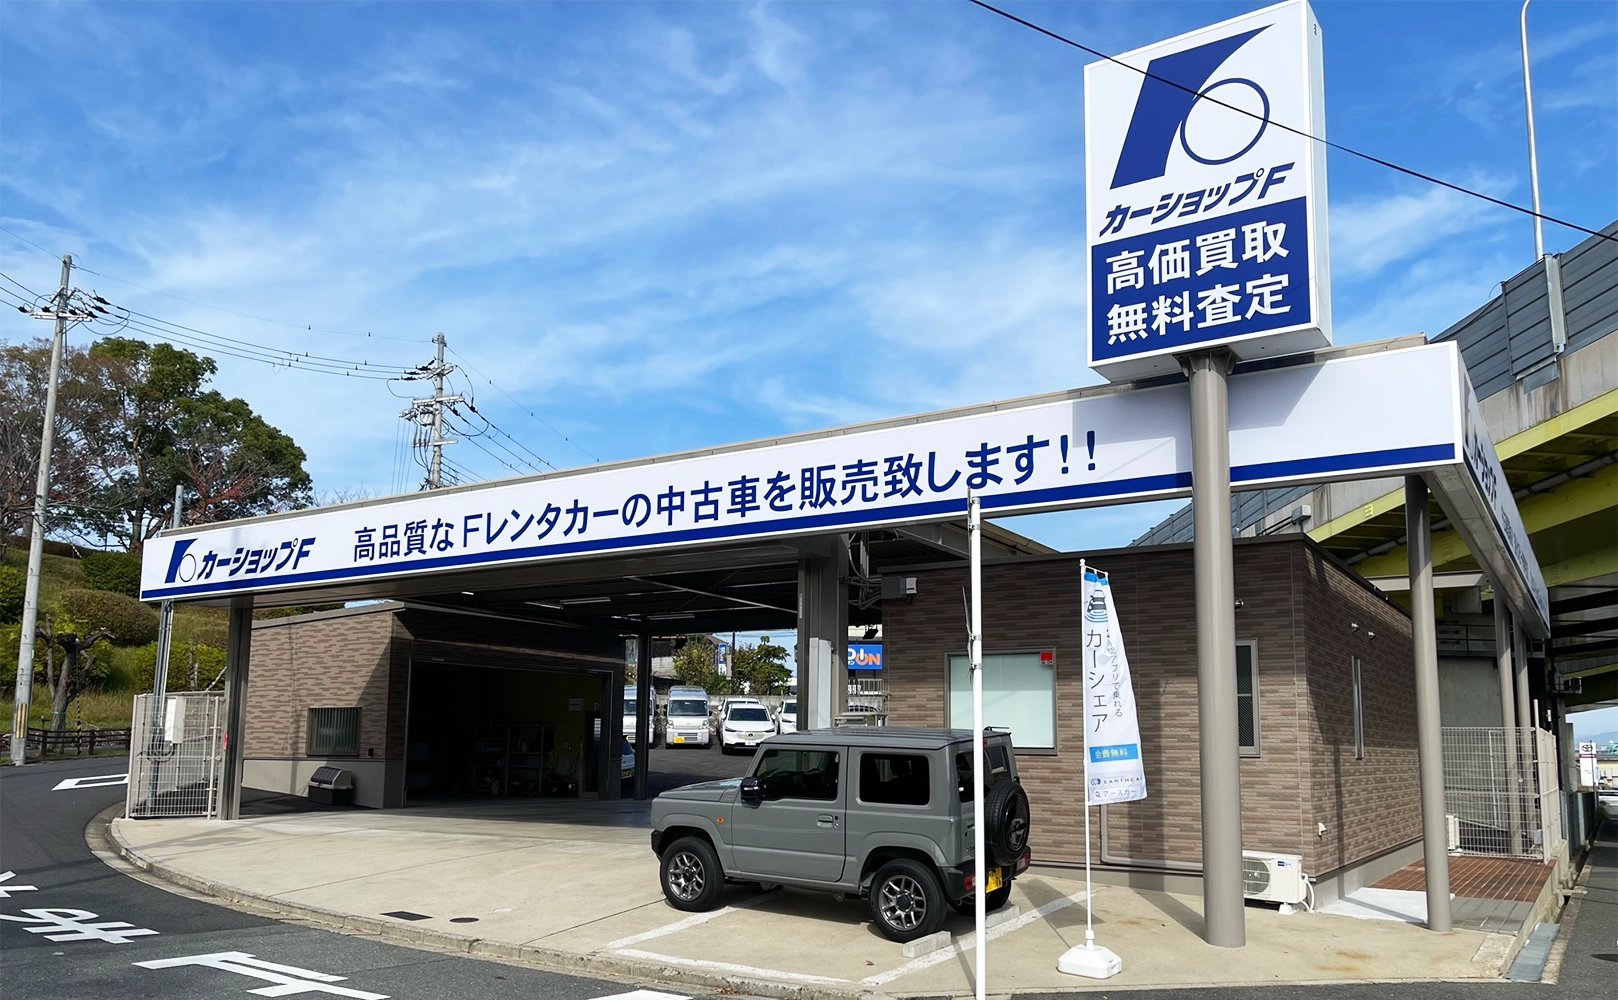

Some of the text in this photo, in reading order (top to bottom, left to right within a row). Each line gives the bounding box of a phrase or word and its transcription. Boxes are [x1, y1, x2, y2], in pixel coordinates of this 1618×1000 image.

[1099, 162, 1295, 237] カーショップF
[1106, 220, 1289, 295] 高価買取
[1107, 273, 1291, 345] 無料査定
[197, 537, 316, 580] カーショップF
[1086, 629, 1108, 733] カーシェア
